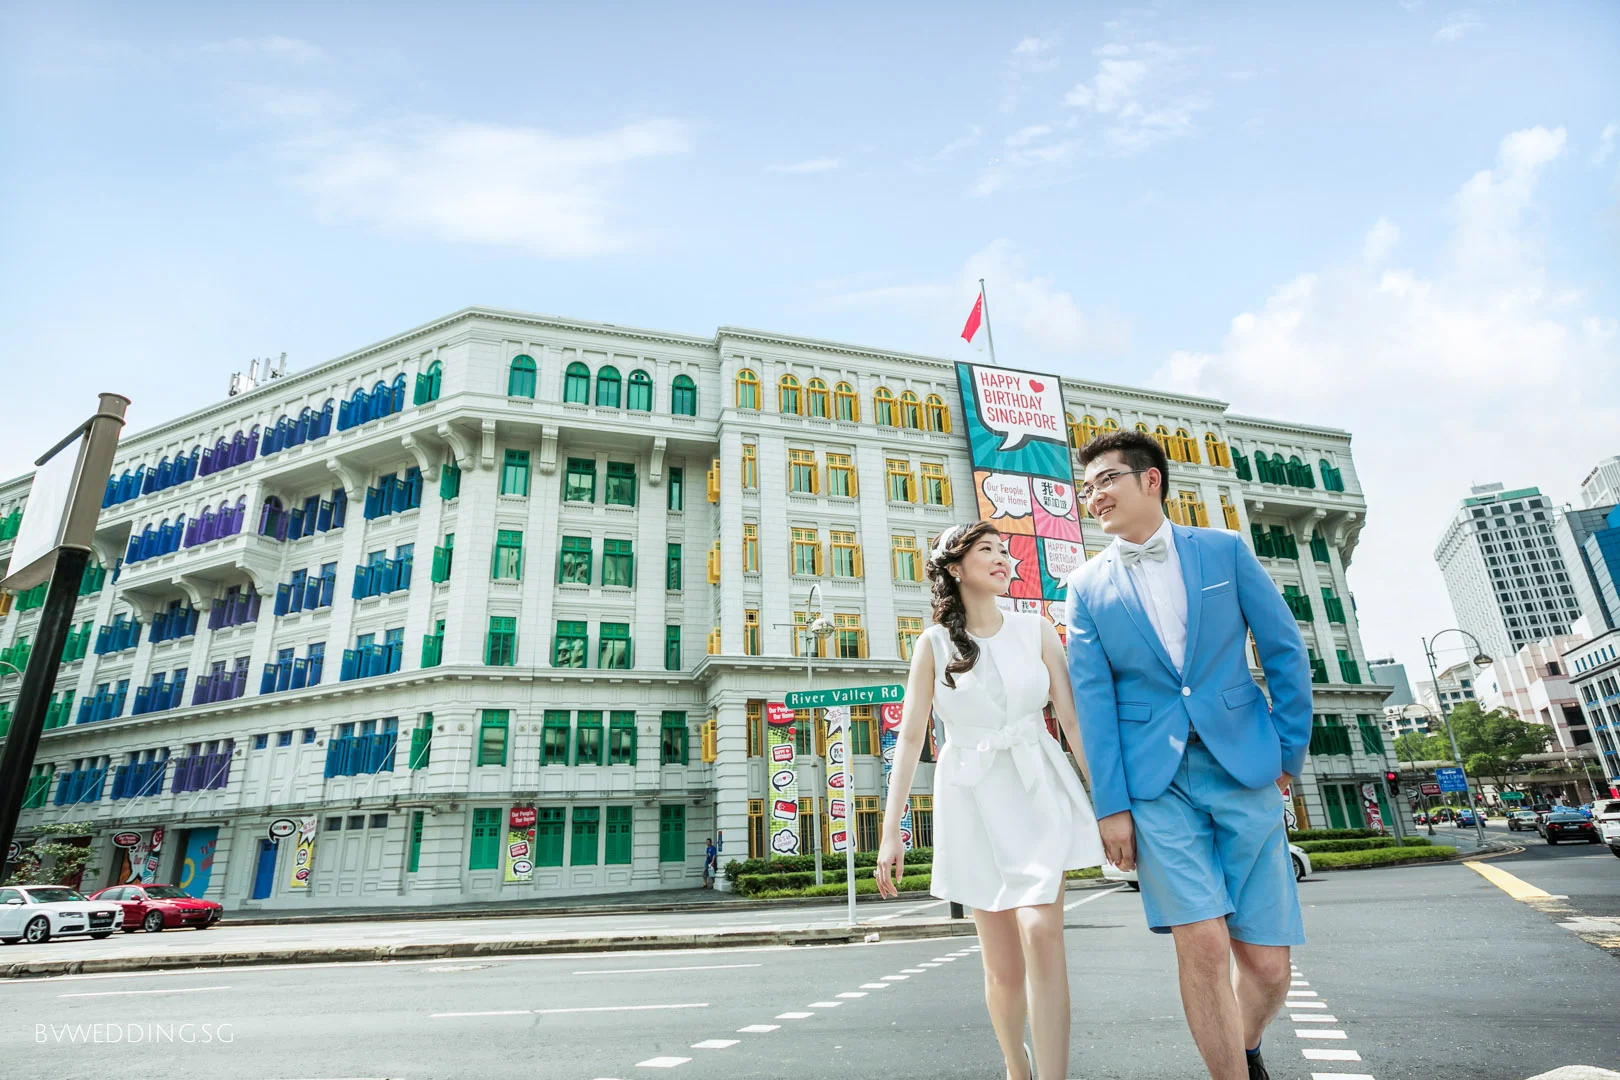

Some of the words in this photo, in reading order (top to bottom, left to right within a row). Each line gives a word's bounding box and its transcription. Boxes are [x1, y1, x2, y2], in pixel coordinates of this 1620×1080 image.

[980, 371, 1021, 391] HAPPY
[983, 389, 1042, 410] BIRTHDAY
[987, 406, 1058, 431] SINGAPORE
[986, 481, 998, 491] Our
[1041, 481, 1054, 496] 我
[994, 493, 1006, 503] Our
[1008, 495, 1028, 506] Home
[1047, 542, 1067, 552] HAPPY
[1049, 552, 1077, 564] BIRTHDAY
[791, 693, 825, 705] River
[832, 689, 874, 702] Valley
[881, 686, 898, 698] Rd
